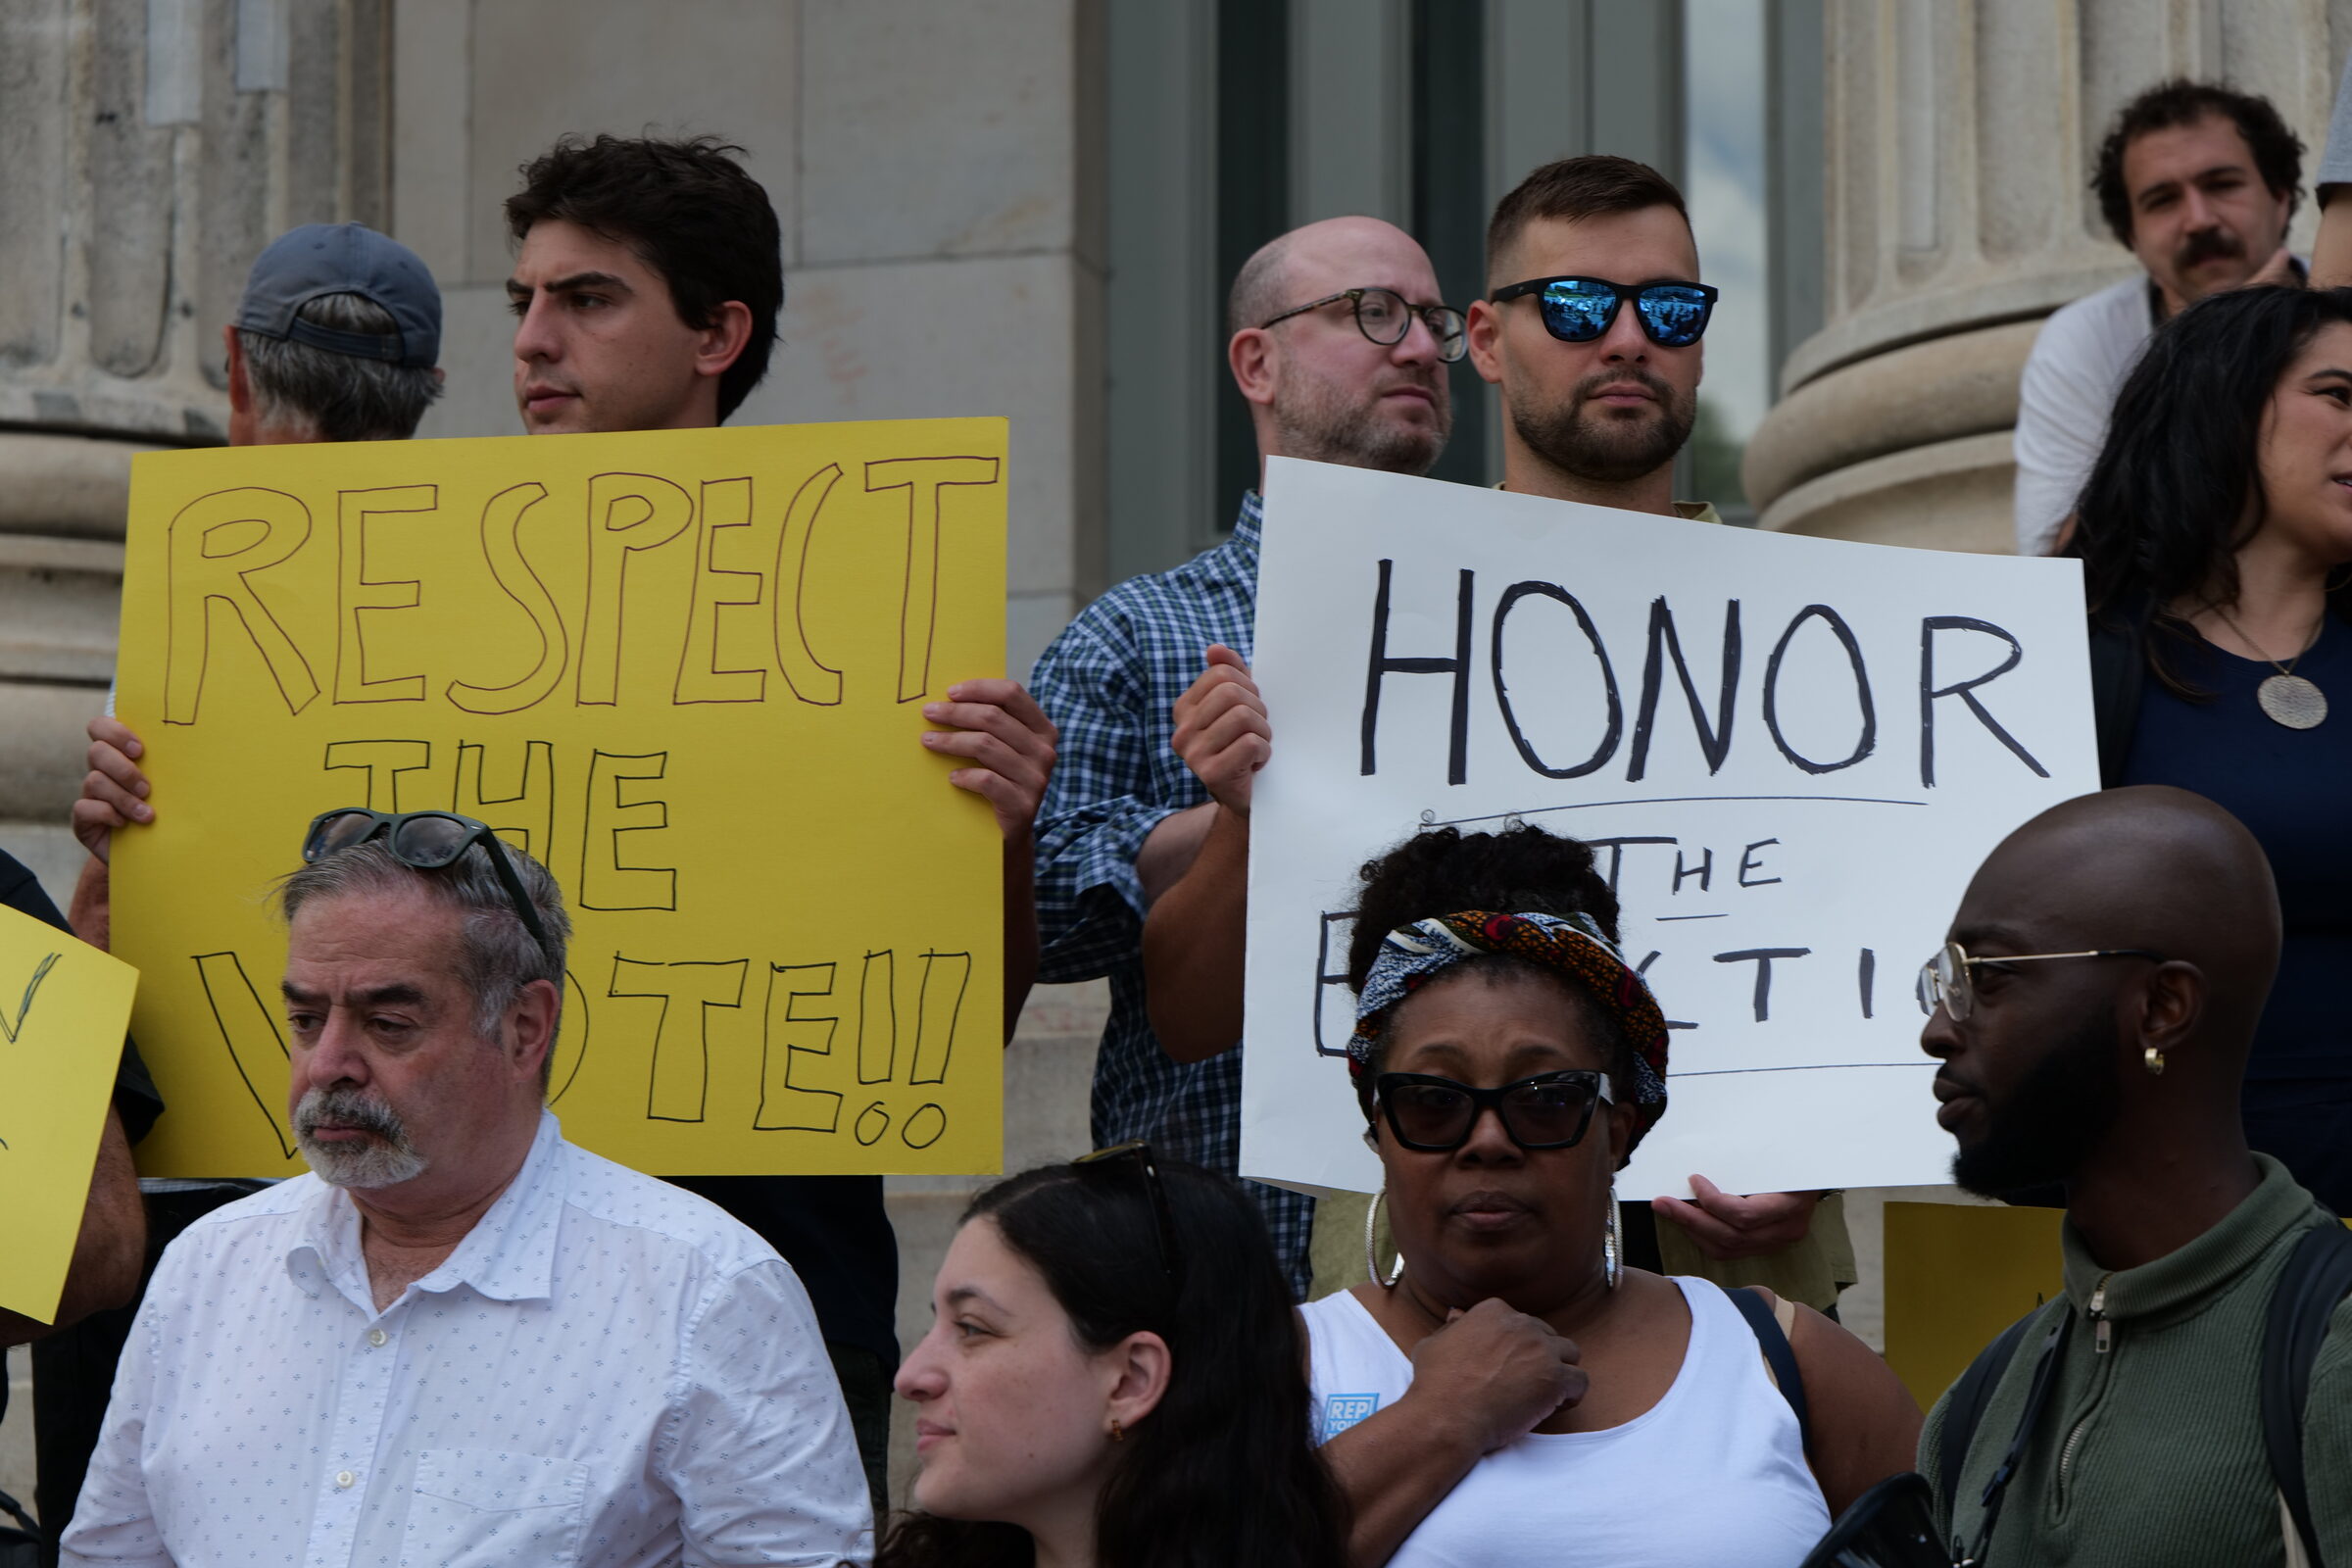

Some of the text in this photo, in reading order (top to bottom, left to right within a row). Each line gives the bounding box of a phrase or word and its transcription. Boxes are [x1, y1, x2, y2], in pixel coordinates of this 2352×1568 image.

[162, 456, 1001, 727] RESPECT
[1359, 557, 2051, 790] HONOR
[324, 739, 676, 911] THE
[1582, 835, 1784, 897] THE
[190, 948, 971, 1159] VTE!!
[1330, 1401, 1368, 1419] REP
